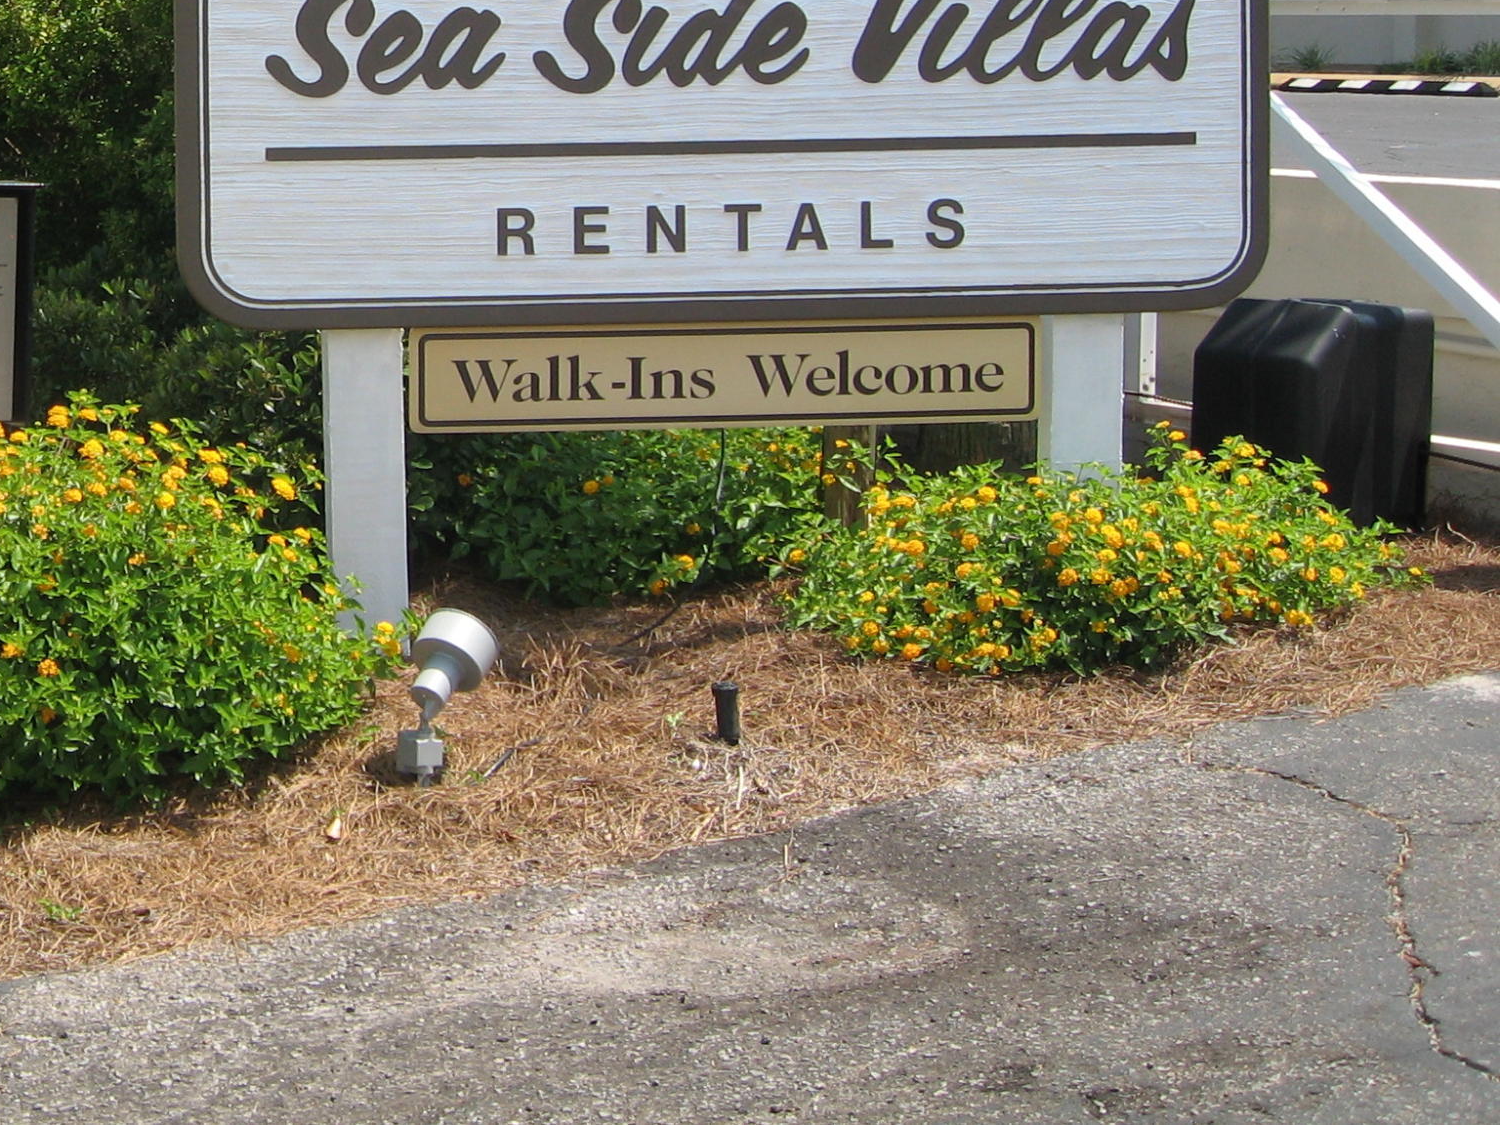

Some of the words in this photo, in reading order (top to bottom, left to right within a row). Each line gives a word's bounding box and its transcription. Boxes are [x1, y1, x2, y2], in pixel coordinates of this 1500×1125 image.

[496, 198, 966, 257] RENTALS
[451, 354, 716, 404] Walk-Ins
[745, 349, 1005, 399] Welcome
